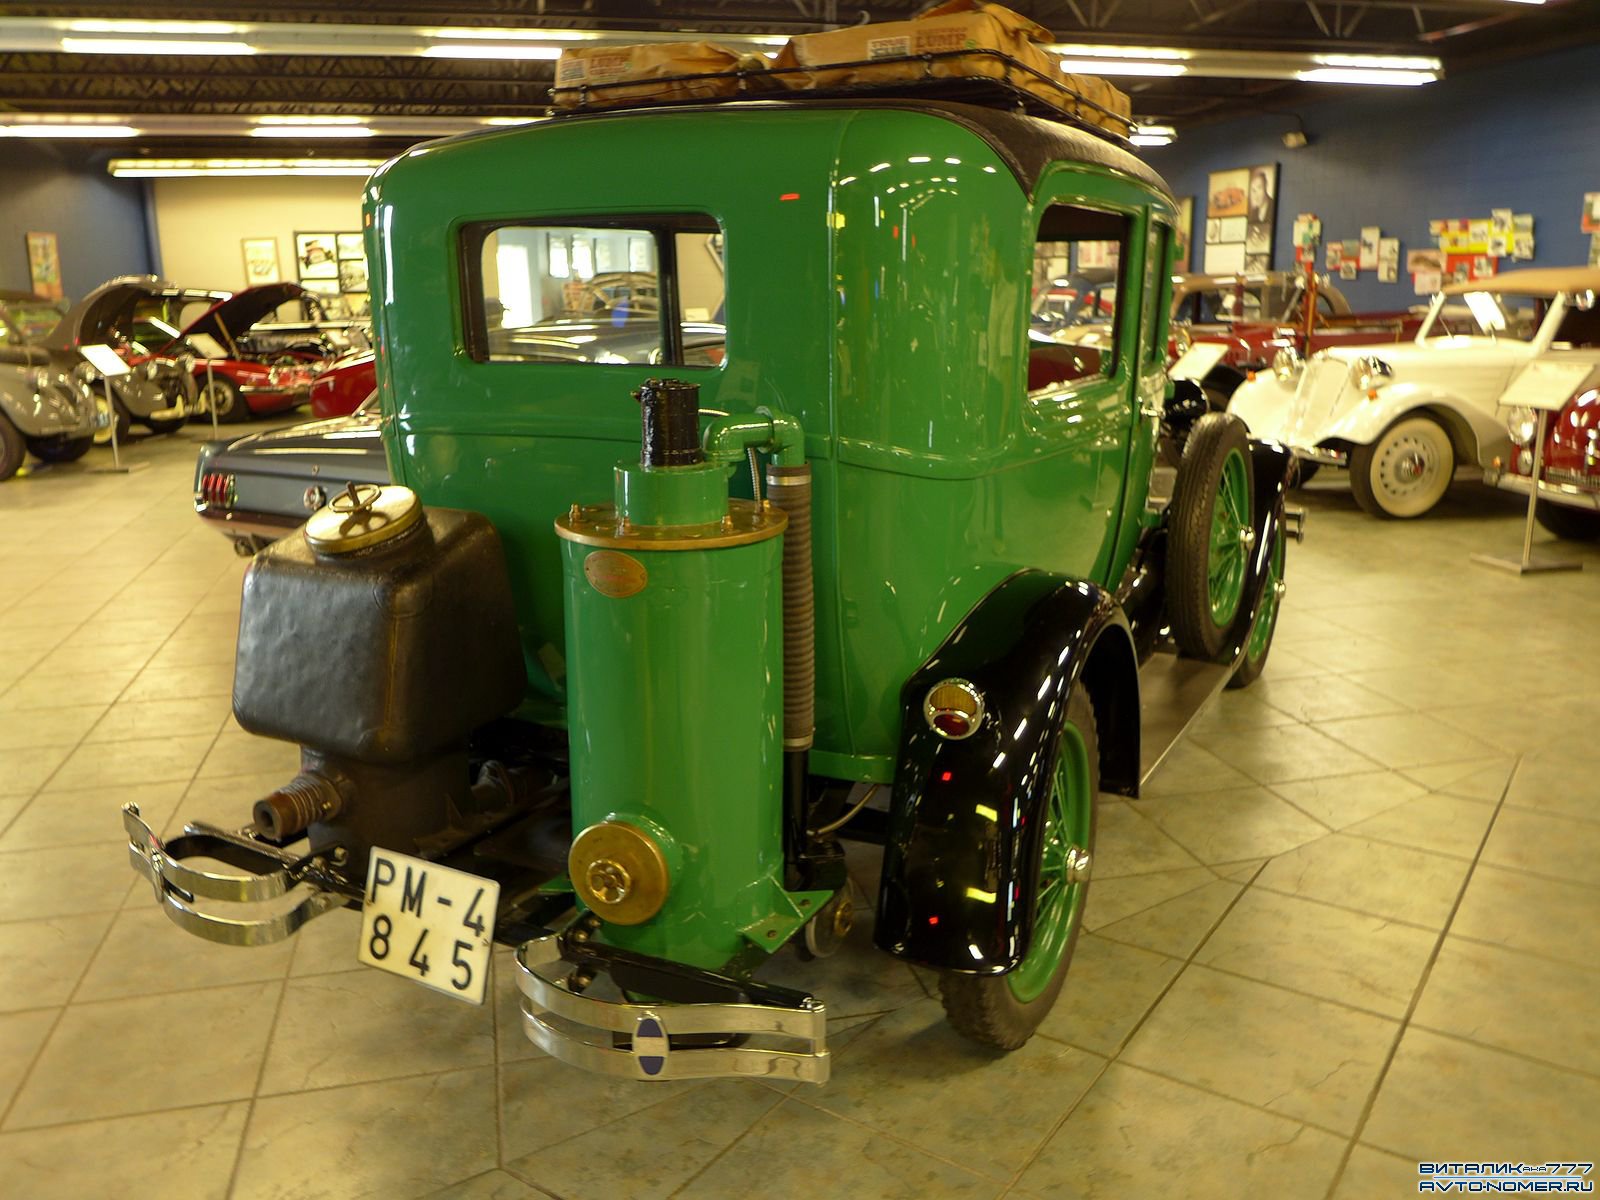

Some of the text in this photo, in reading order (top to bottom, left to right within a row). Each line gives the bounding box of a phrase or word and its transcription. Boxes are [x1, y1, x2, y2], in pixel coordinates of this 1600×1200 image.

[916, 33, 967, 48] LUMP
[371, 857, 486, 937] PM-4
[369, 914, 475, 991] 845
